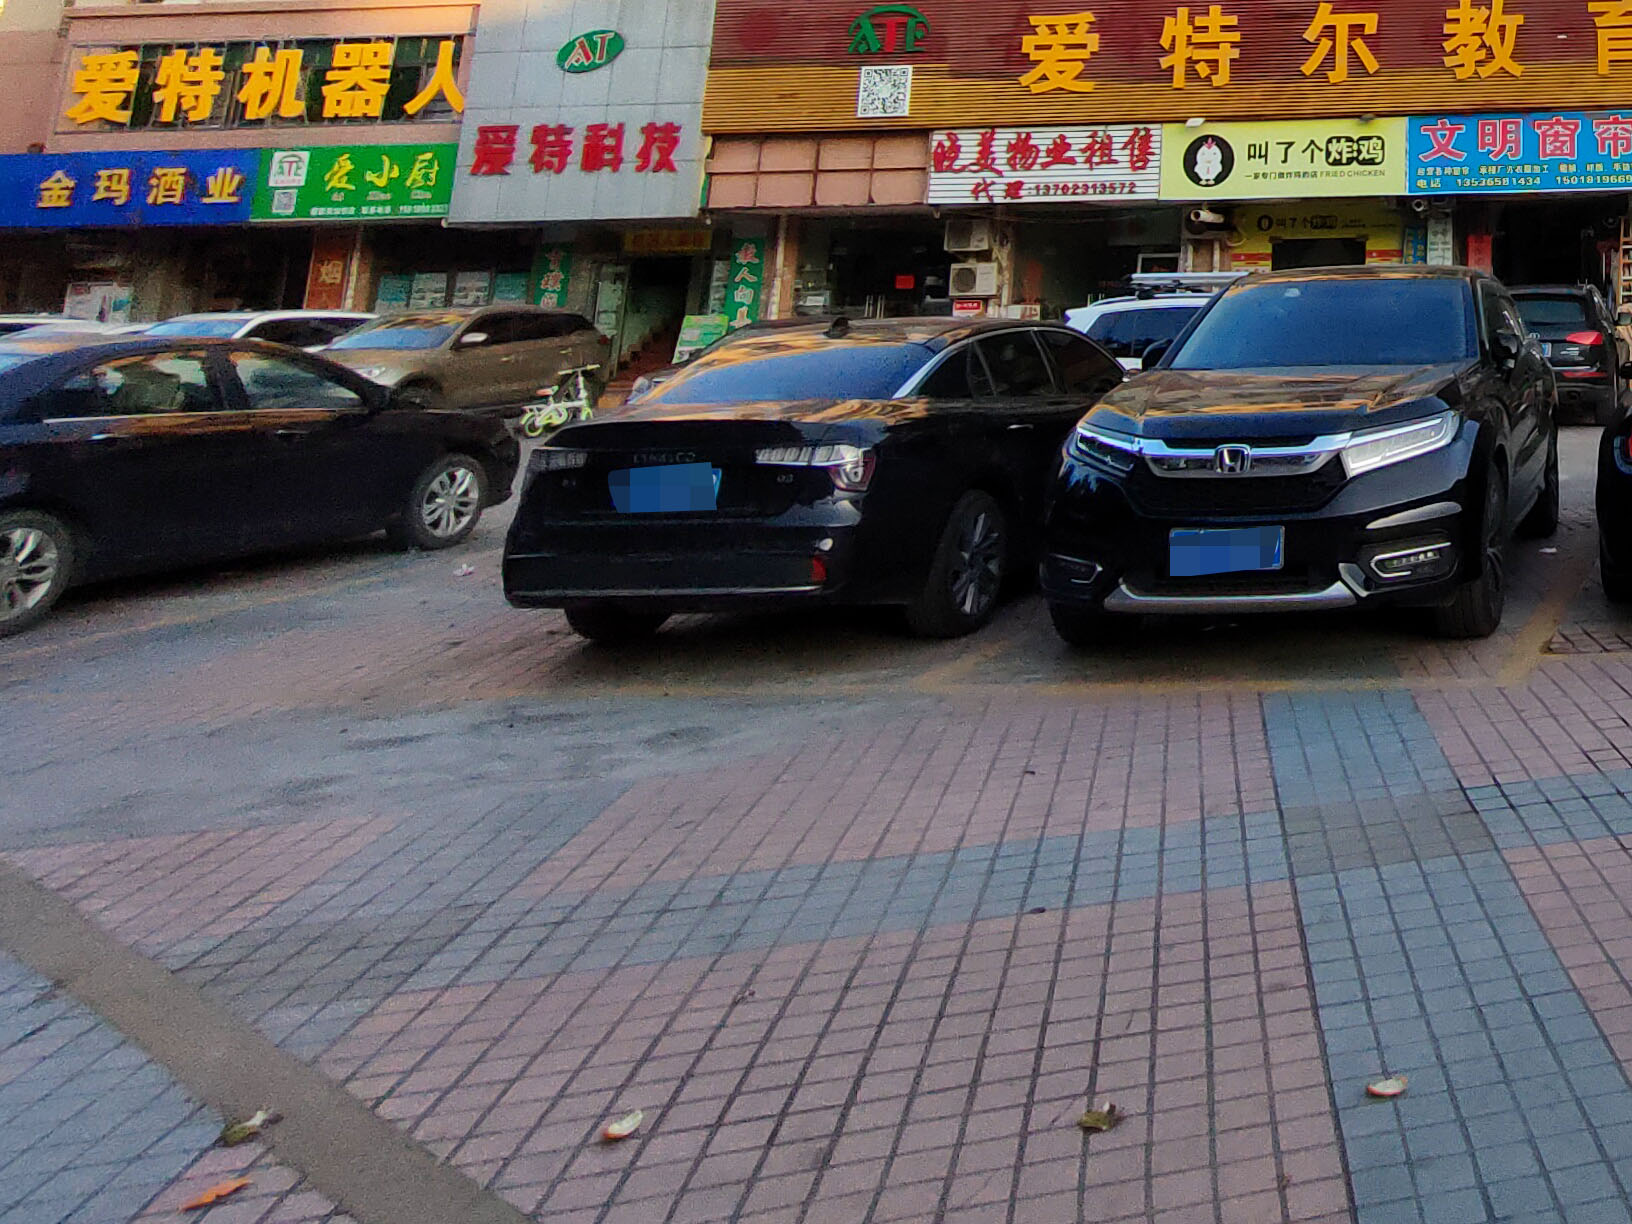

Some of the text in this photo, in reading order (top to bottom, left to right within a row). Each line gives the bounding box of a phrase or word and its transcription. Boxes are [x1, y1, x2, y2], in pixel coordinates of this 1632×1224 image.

[565, 32, 614, 67] AT
[66, 40, 466, 124] 爱特机器人
[470, 122, 682, 176] 爱特科技
[1247, 136, 1385, 166] 叫了个炸鸡
[36, 167, 245, 208] 金玛酒业
[323, 152, 439, 191] 爱小厨
[1319, 170, 1345, 178] FRIED
[1347, 169, 1386, 178] CHICKEN
